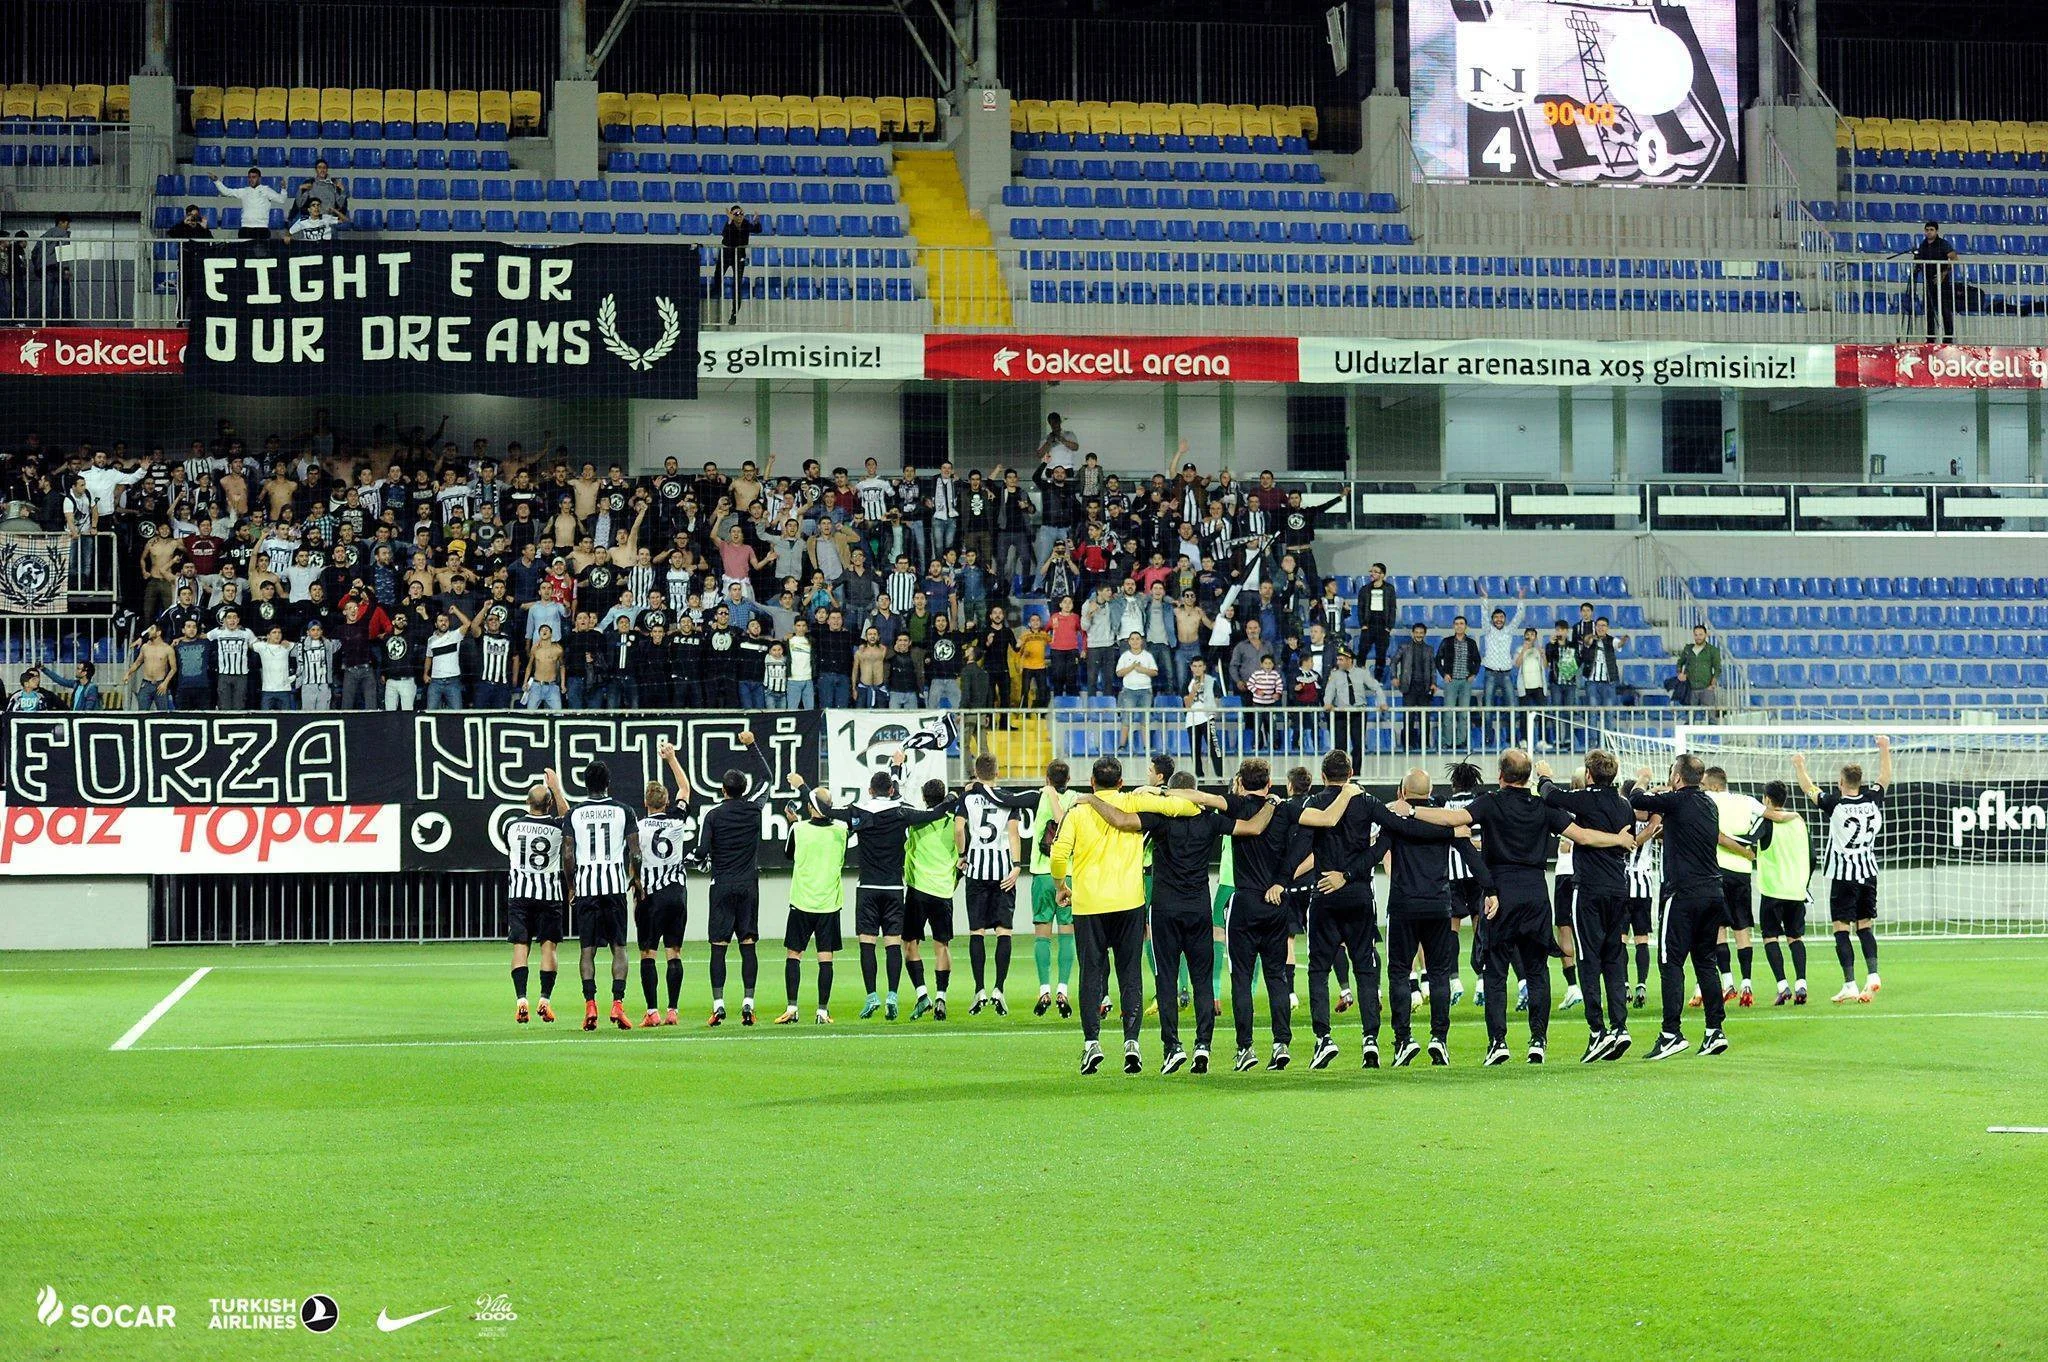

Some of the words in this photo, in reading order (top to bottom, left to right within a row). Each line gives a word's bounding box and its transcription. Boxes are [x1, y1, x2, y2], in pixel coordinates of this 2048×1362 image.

[1481, 127, 1516, 172] 4
[55, 339, 169, 366] bakcell
[727, 344, 881, 374] gəlmisiniz!
[1026, 348, 1133, 374] bakcell
[1142, 353, 1230, 376] arena
[1335, 350, 1449, 375] Ulduzlar
[1457, 356, 1592, 376] arenasına
[1600, 358, 1645, 383] xoş
[1653, 354, 1796, 385] gəlmisiniz!
[1928, 354, 2023, 379] bakcell
[516, 825, 554, 836] AXUNDOV
[580, 810, 616, 820] KARIKARI
[979, 808, 998, 844] 5
[586, 822, 611, 861] 11
[651, 827, 673, 859] 6
[1843, 815, 1875, 849] 25
[517, 834, 551, 870] 18
